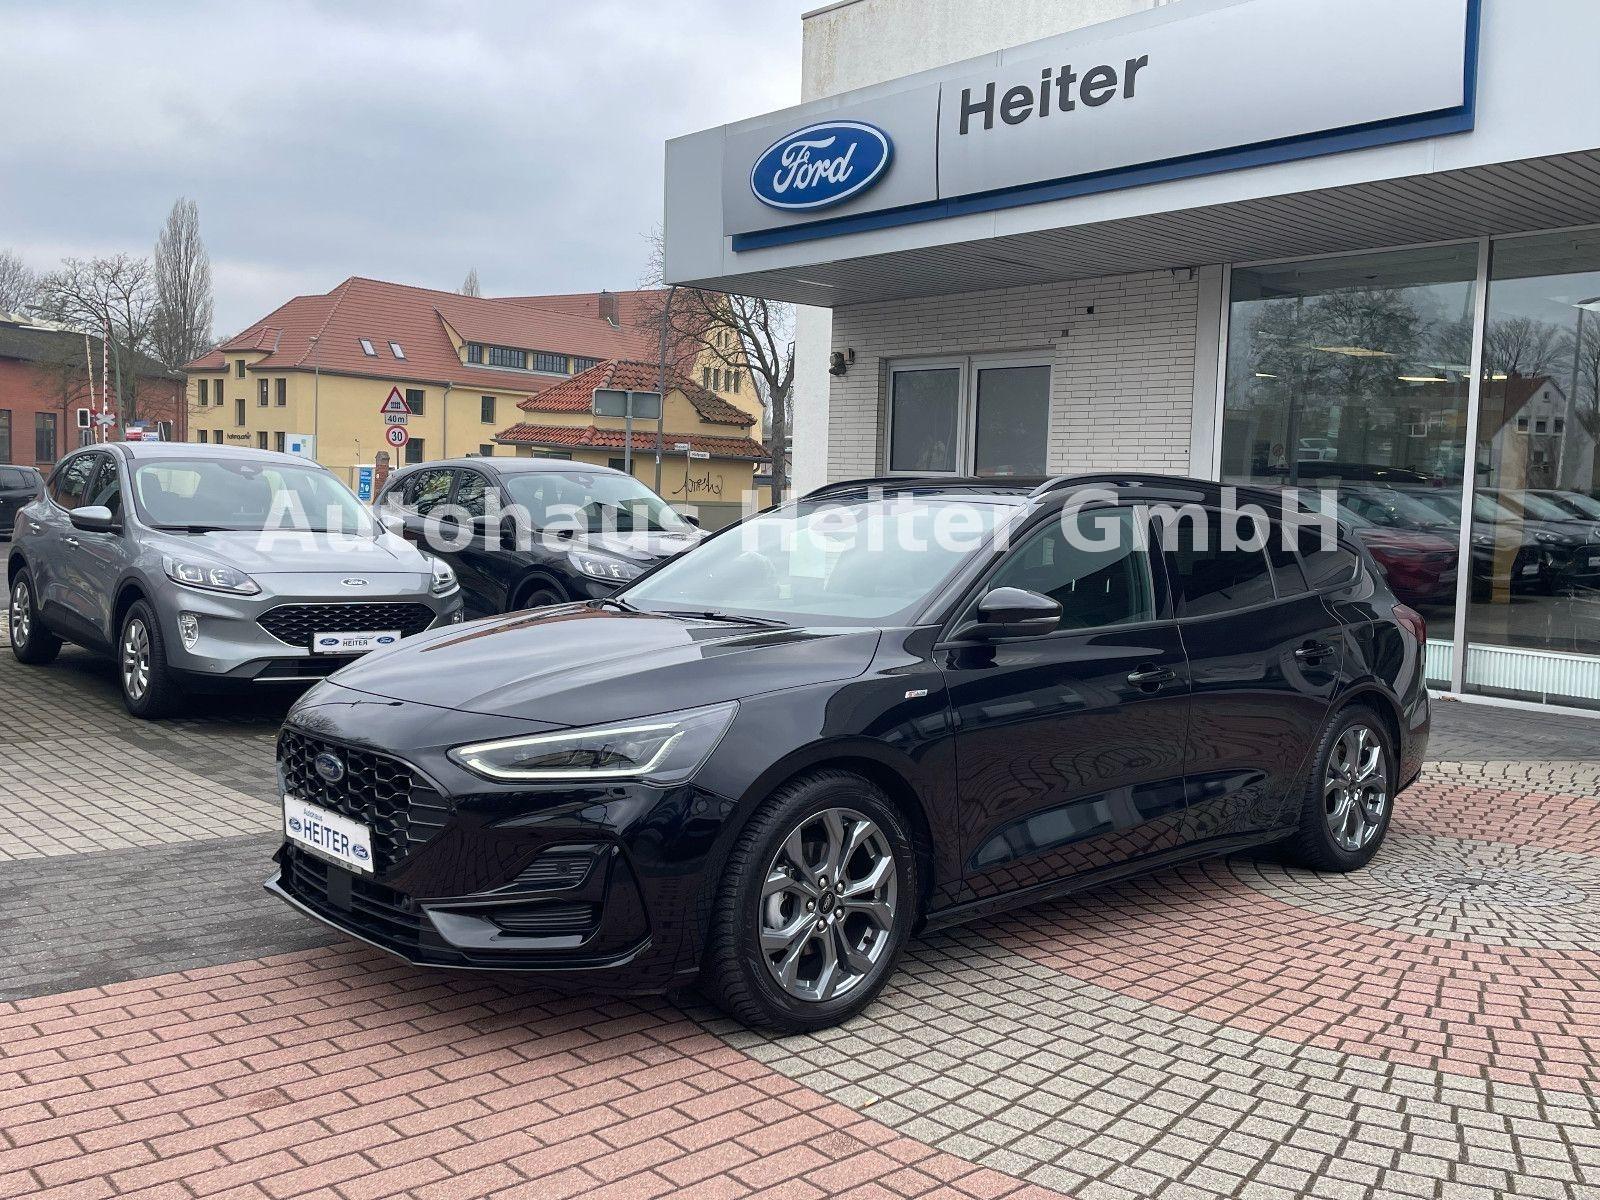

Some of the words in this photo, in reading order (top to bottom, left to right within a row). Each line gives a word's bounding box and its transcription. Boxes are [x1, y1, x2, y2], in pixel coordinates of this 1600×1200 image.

[958, 54, 1149, 135] Heiter
[773, 135, 857, 194] Ford
[391, 431, 403, 442] 30
[303, 818, 350, 857] HEITER
